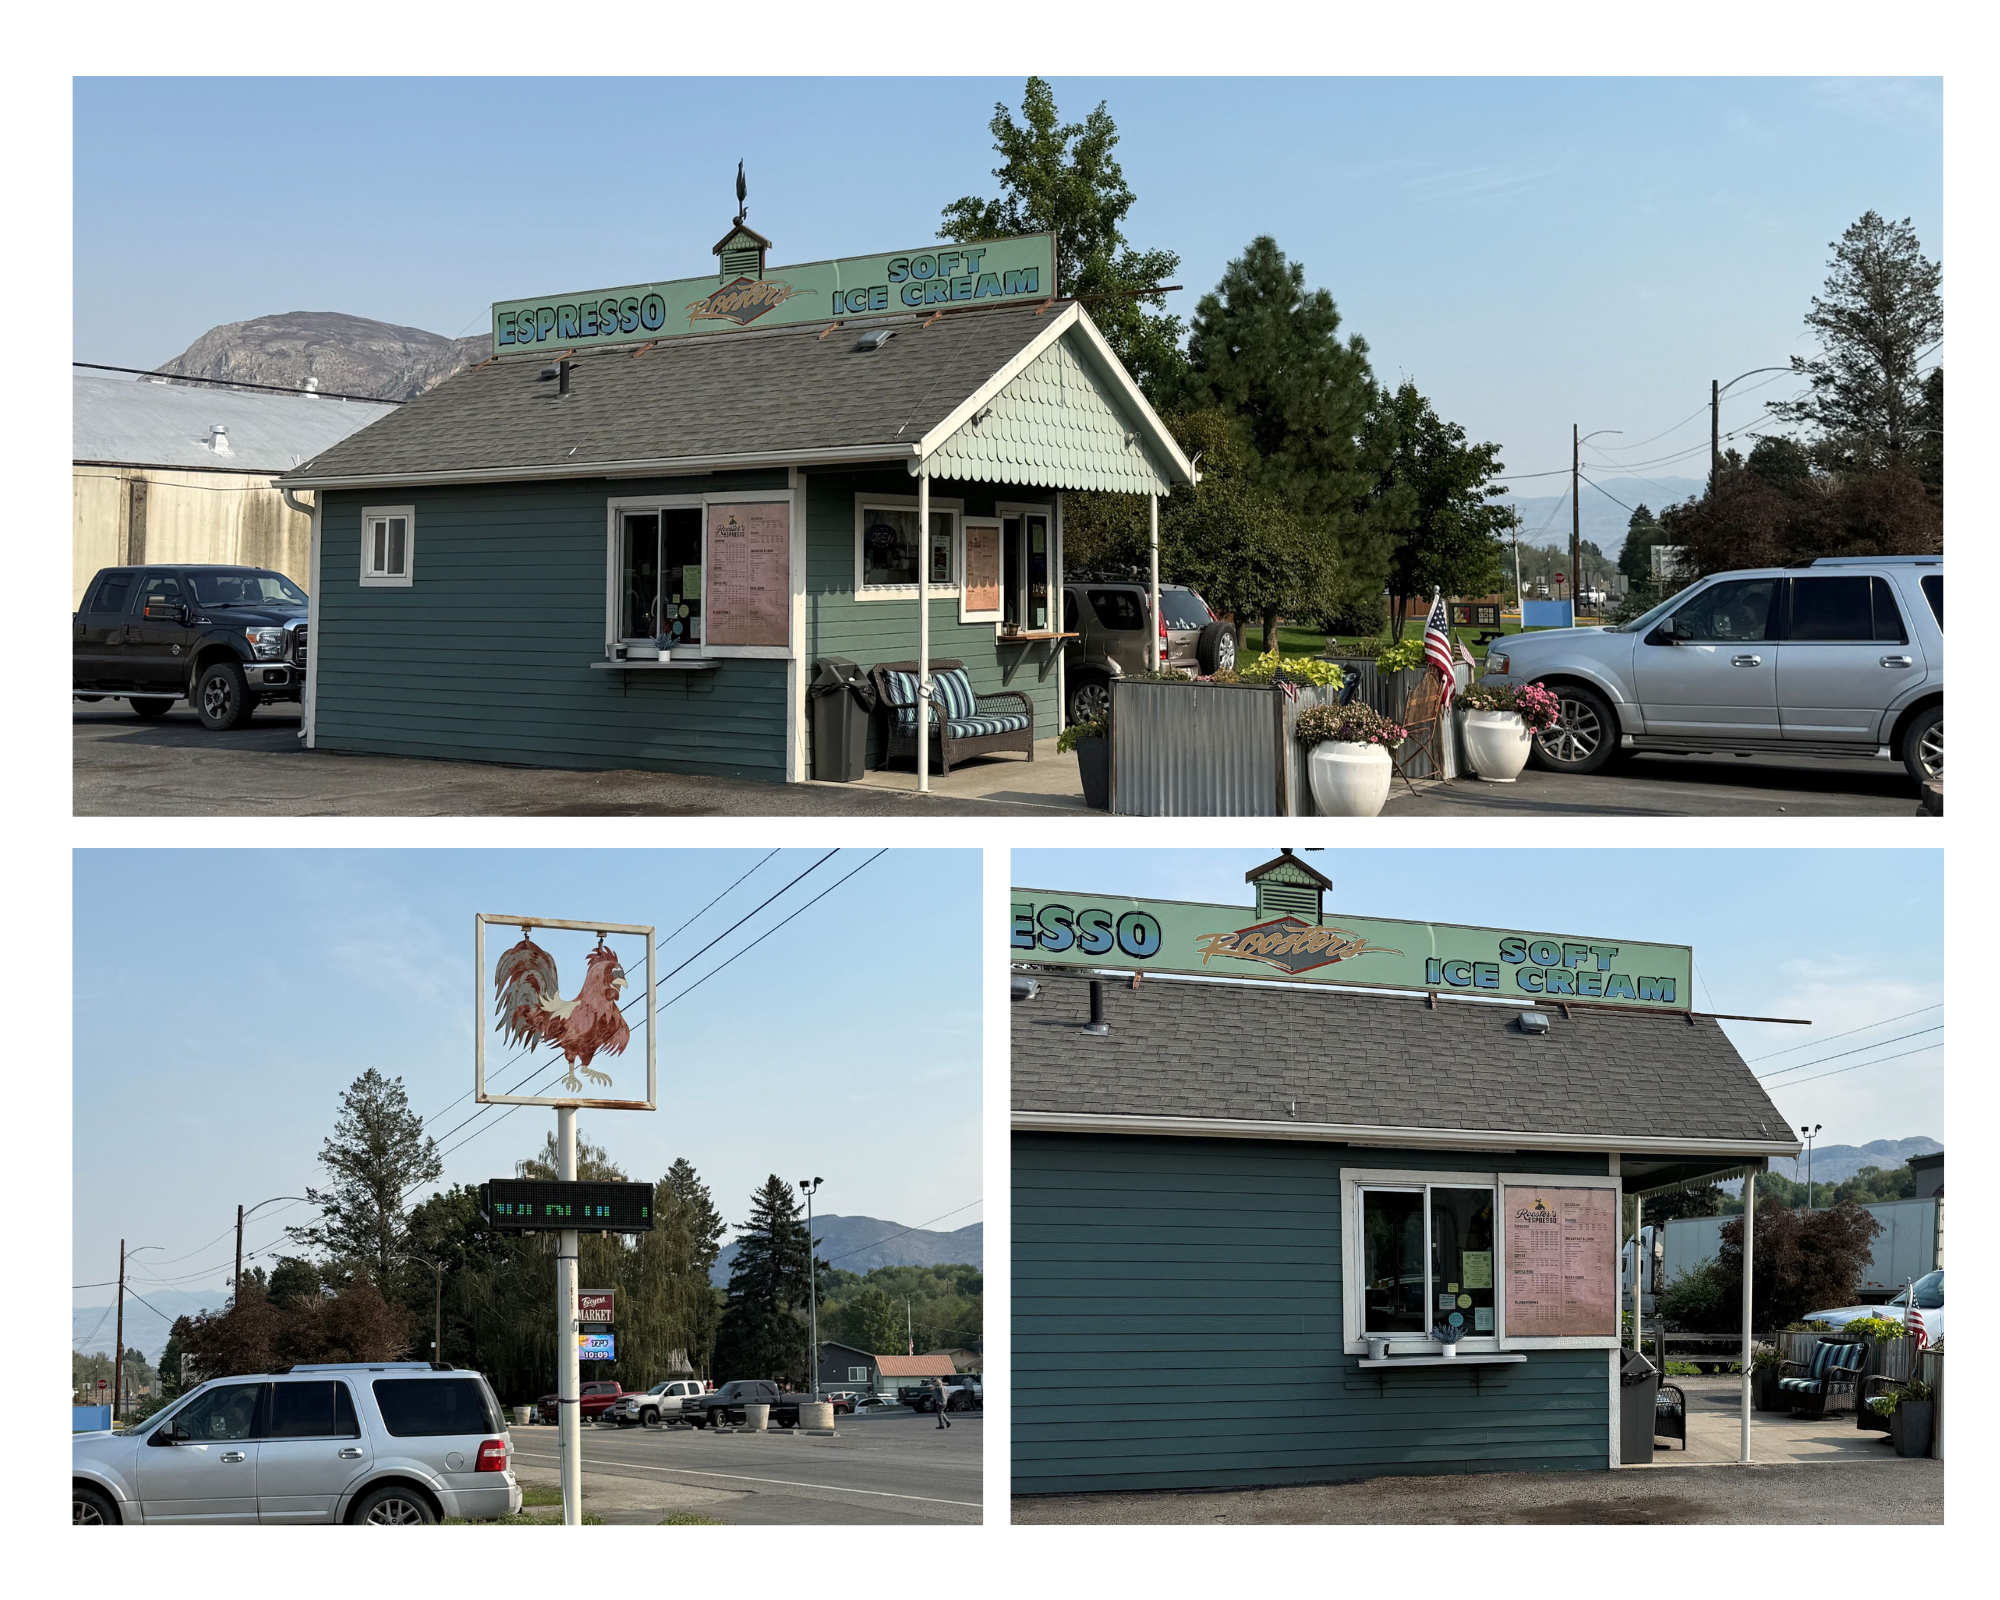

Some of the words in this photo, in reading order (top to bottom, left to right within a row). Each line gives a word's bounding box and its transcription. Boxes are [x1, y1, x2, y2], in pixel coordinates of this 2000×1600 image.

[887, 248, 986, 283] SOFT
[684, 279, 818, 329] Roosters
[833, 285, 888, 316] ICE
[901, 266, 1039, 307] CREAM
[498, 293, 666, 346] ESPRESSO
[1011, 903, 1163, 959] ESSO
[1194, 923, 1404, 967] Roosters
[1499, 937, 1619, 971] SOFT
[1426, 957, 1500, 989] ICE
[1516, 967, 1676, 1003] CREAM
[1515, 1209, 1557, 1220] Rooster's
[584, 1351, 609, 1359] 10:09
